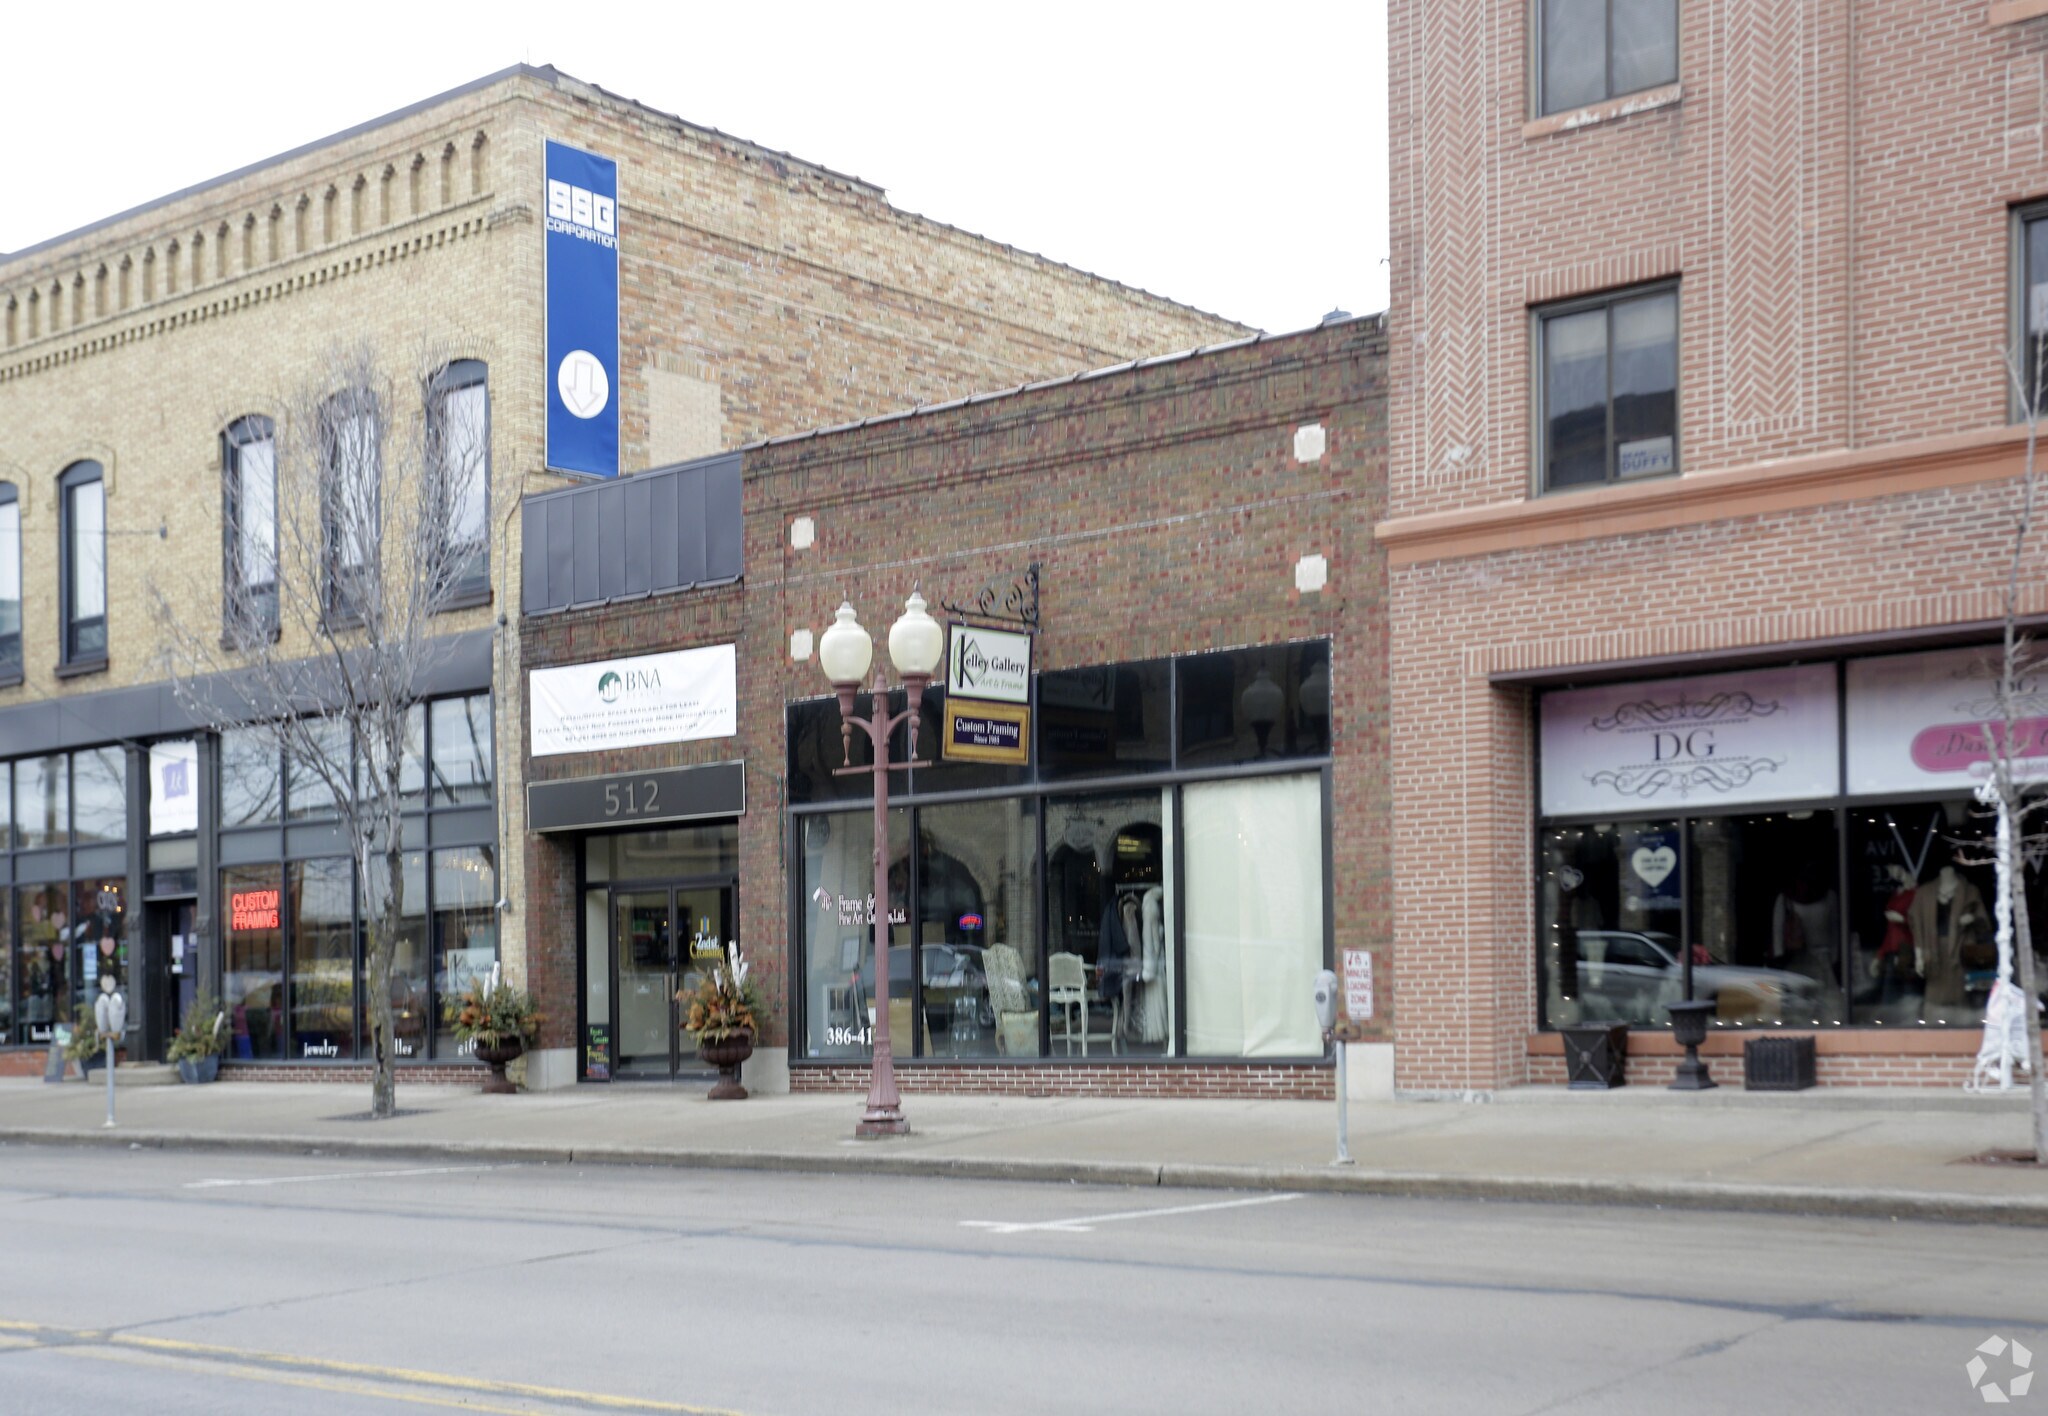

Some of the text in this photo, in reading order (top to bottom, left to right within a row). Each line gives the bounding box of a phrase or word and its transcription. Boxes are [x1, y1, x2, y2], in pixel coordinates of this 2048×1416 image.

[548, 179, 615, 235] SSG
[546, 217, 617, 250] CORPORATION
[1622, 452, 1670, 472] DUFFY
[959, 634, 1026, 689] Kelley Gallery
[626, 668, 662, 691] BNA
[956, 718, 1018, 740] Custom Framing
[1652, 727, 1715, 761] DG
[605, 779, 660, 816] 512
[232, 889, 279, 912] CUSTOM
[838, 894, 863, 912] Frame
[232, 909, 279, 931] FRAMING
[852, 911, 863, 925] Art
[304, 1038, 338, 1057] jewelry
